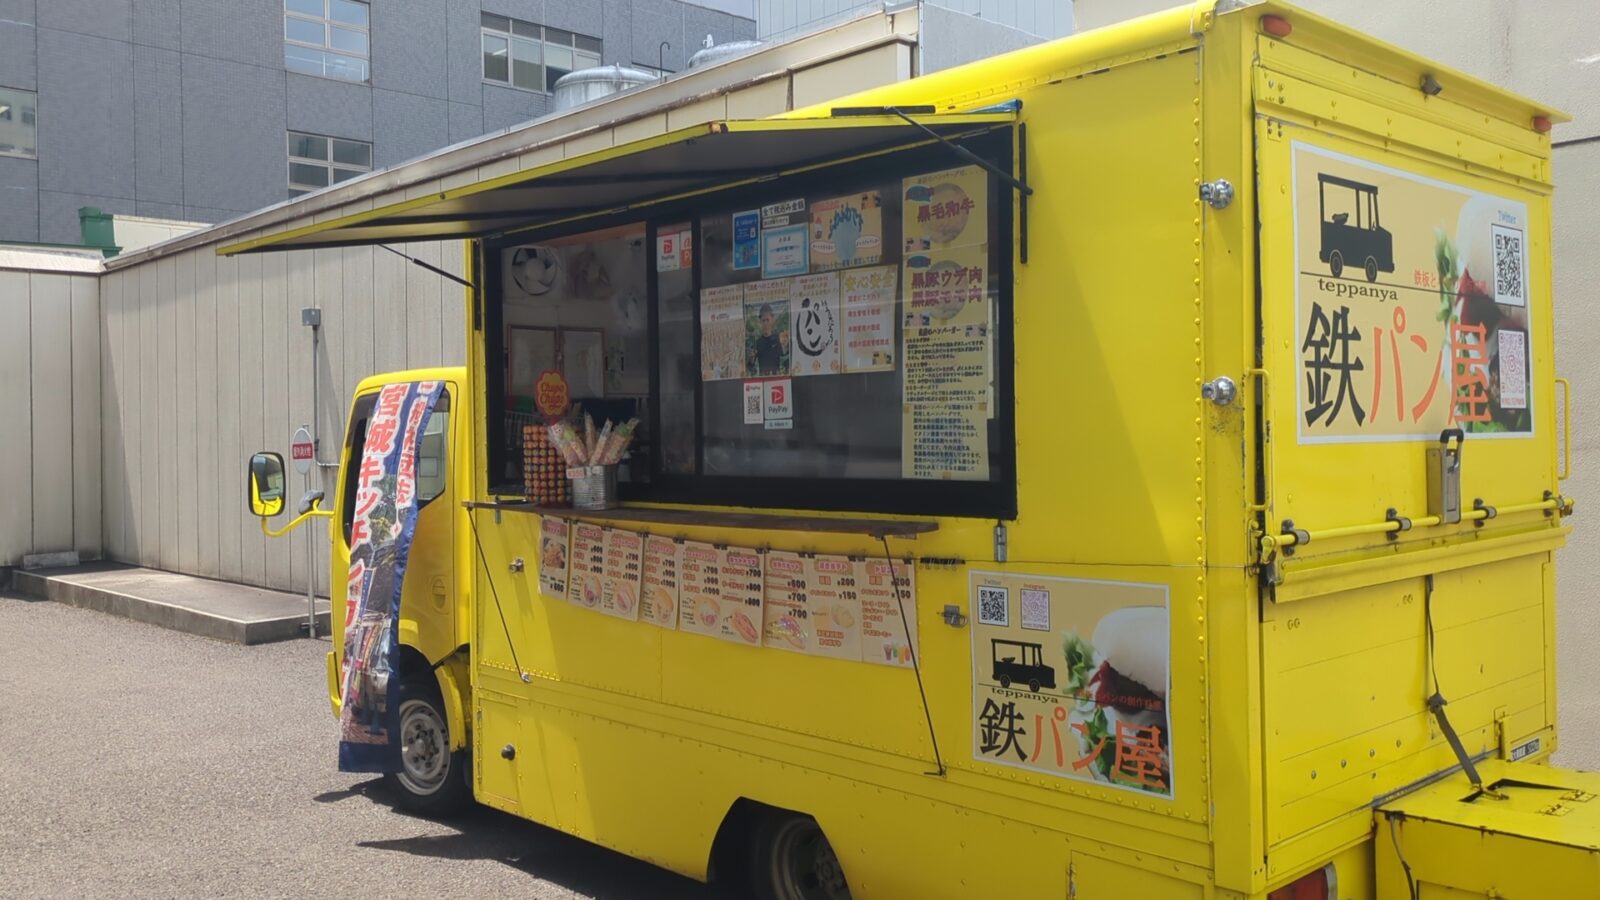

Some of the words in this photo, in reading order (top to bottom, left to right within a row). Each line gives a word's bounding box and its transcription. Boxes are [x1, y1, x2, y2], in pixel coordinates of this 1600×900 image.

[917, 197, 975, 222] 黒毛和牛
[1318, 277, 1398, 302] teppanya
[1302, 301, 1493, 427] 鉄パン屋
[768, 405, 788, 415] PayPay
[704, 566, 718, 575] ¥700
[746, 569, 761, 578] ¥700
[837, 578, 855, 587] ¥200
[788, 593, 806, 602] ¥700
[838, 591, 857, 600] ¥150
[891, 590, 911, 599] ¥50
[788, 609, 807, 619] ¥700
[992, 686, 1059, 704] teppanya
[979, 697, 1167, 790] 鉄パン屋
